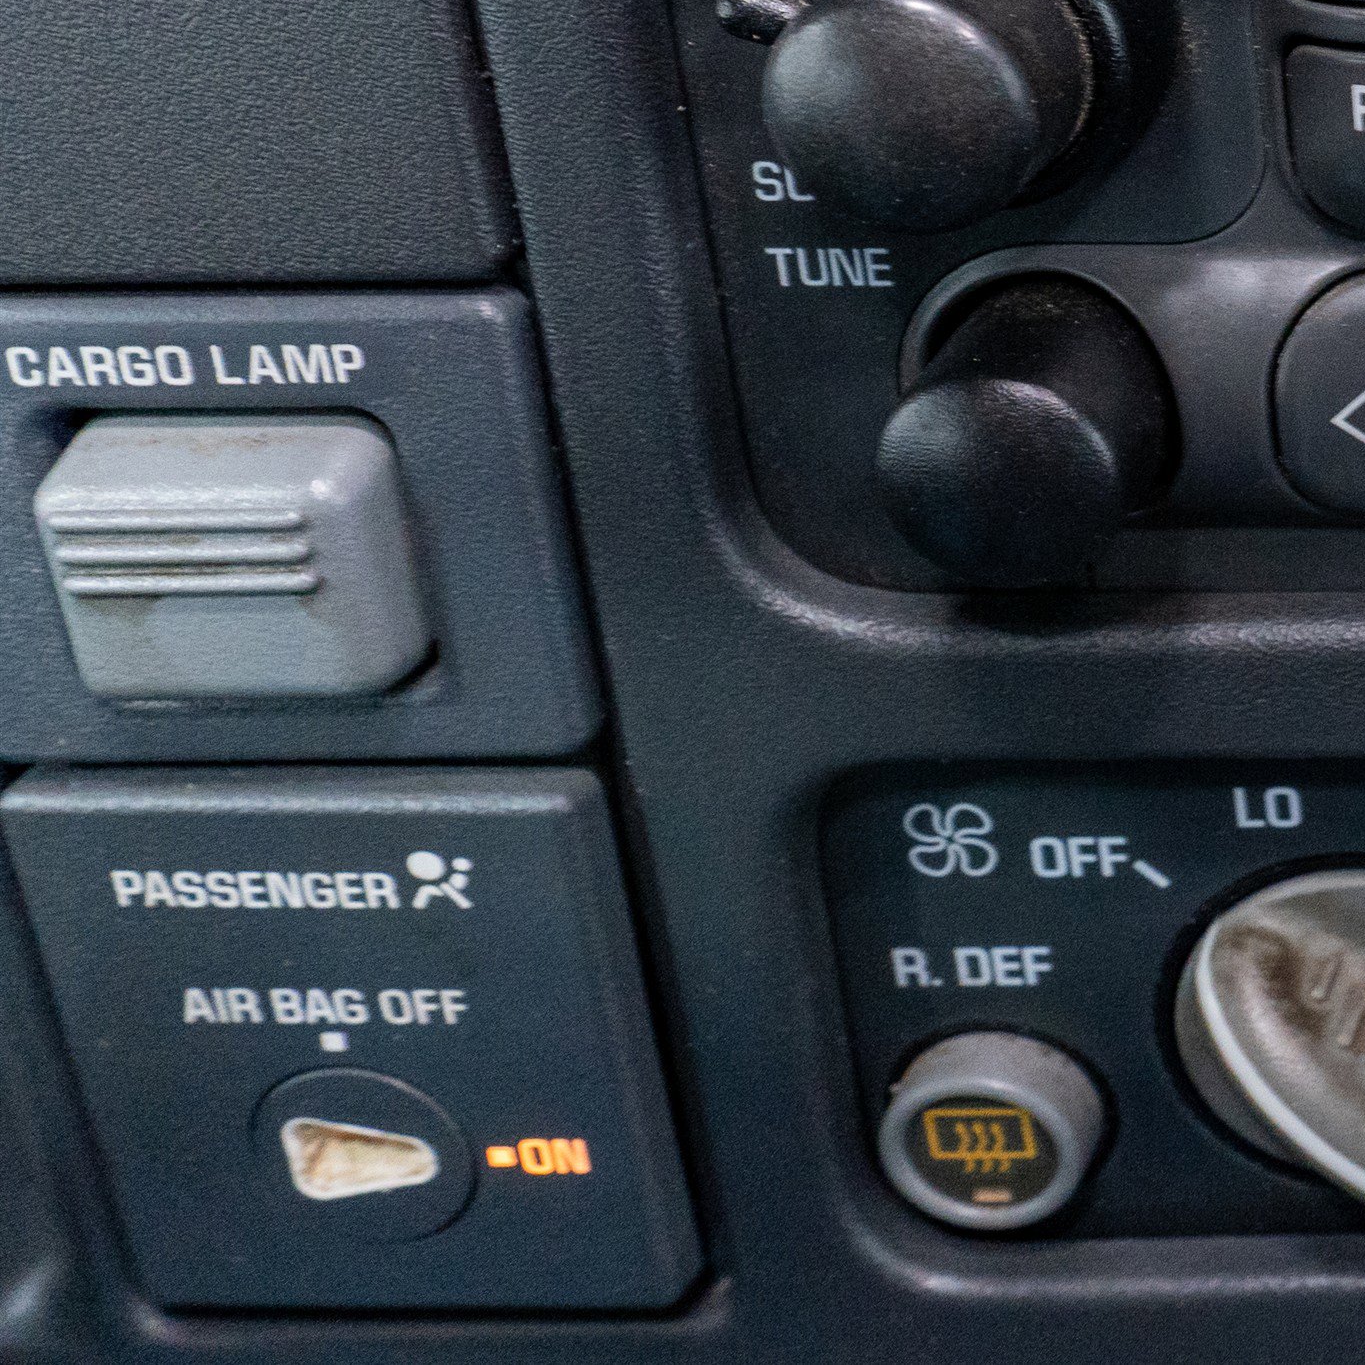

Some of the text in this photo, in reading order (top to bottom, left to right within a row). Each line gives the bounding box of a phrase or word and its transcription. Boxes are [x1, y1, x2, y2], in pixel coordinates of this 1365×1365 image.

[764, 246, 893, 288] TUNE
[4, 343, 365, 388] CARGO LAMP
[1233, 786, 1303, 829] LO
[1029, 836, 1128, 879] OFF
[110, 869, 401, 910] PASSENGER
[891, 945, 1052, 987] R. DEF
[182, 986, 468, 1026] AIR BAG OFF
[516, 1137, 593, 1176] ON
